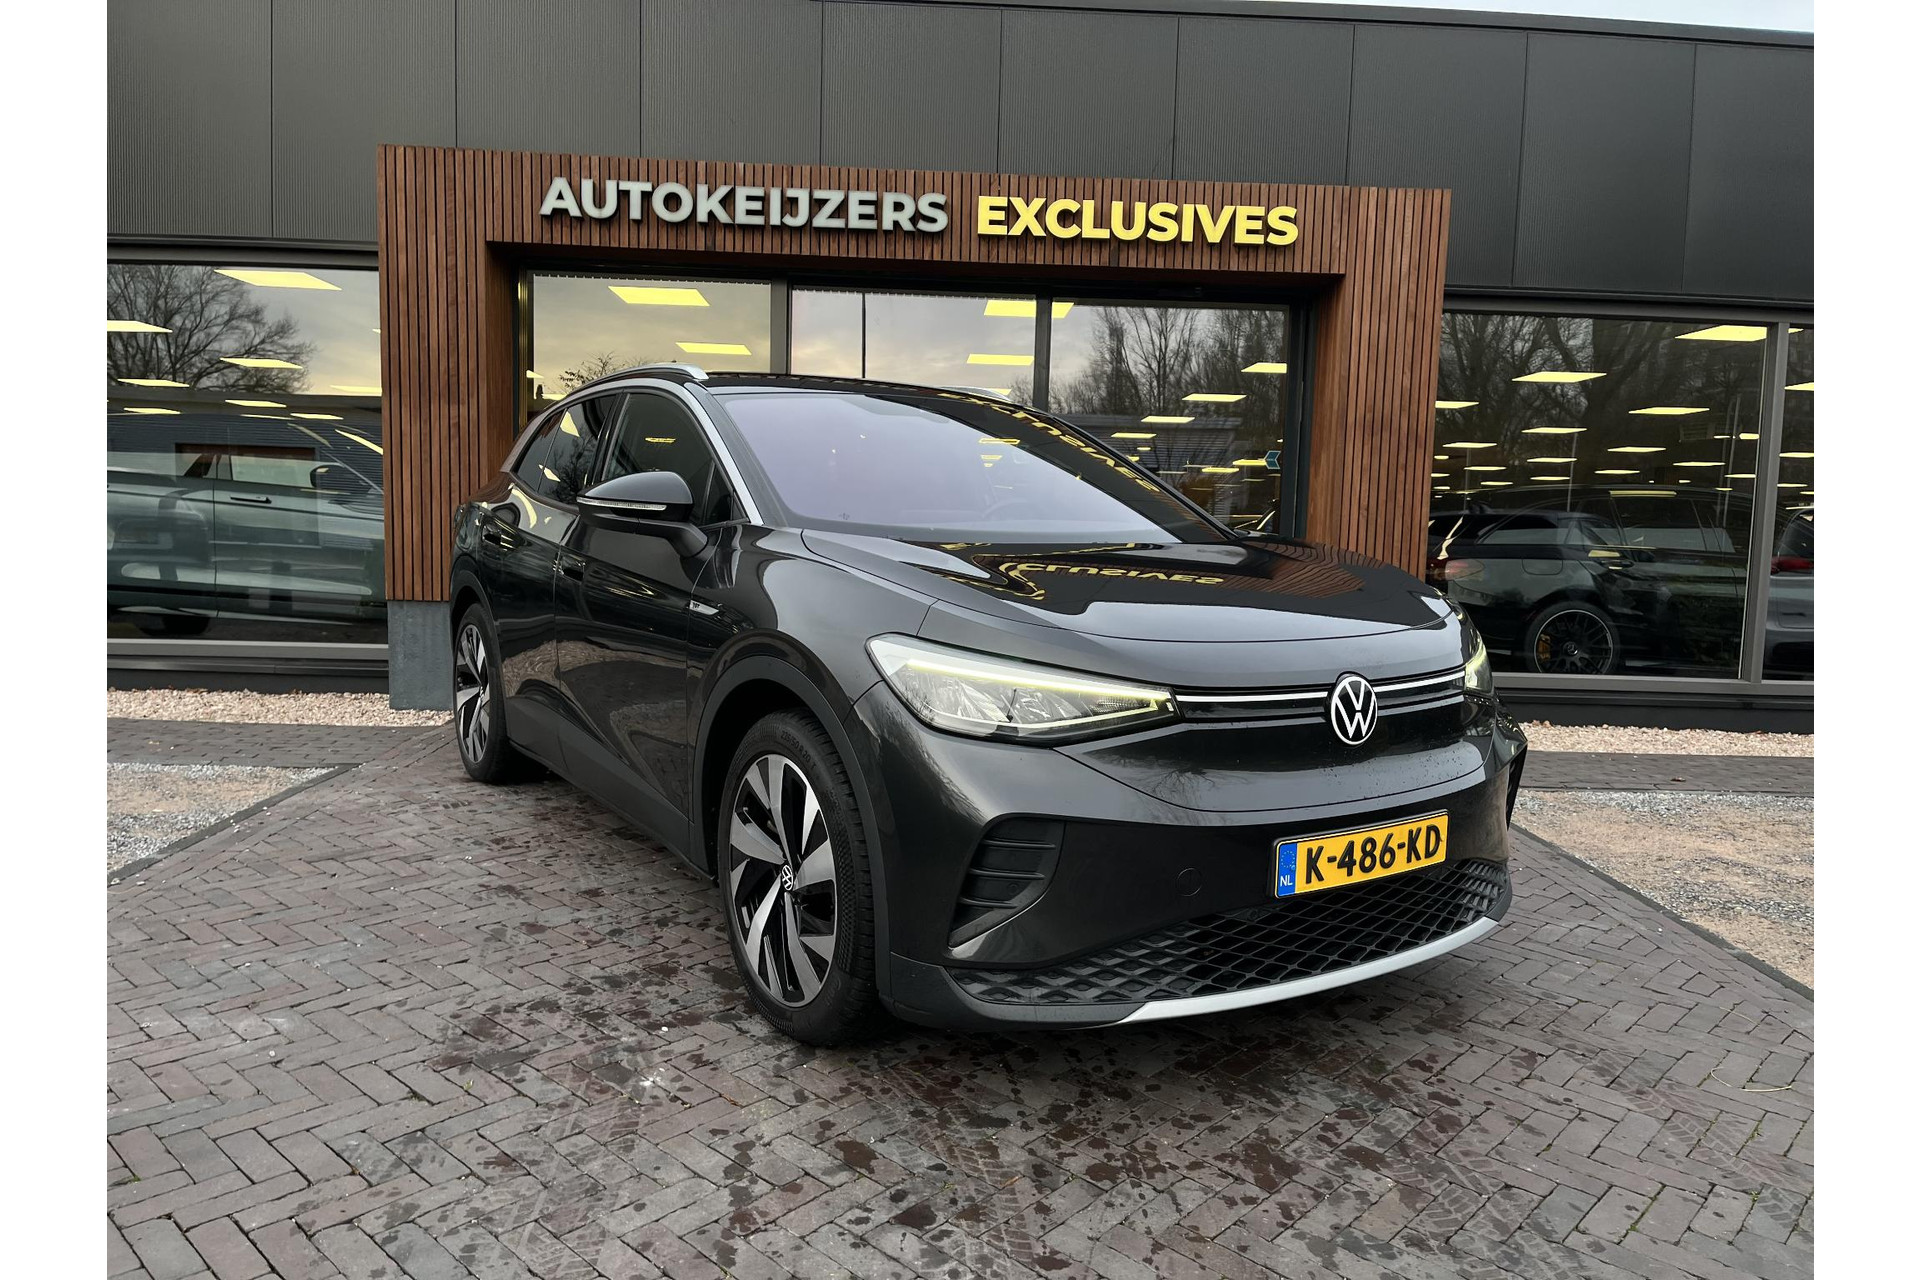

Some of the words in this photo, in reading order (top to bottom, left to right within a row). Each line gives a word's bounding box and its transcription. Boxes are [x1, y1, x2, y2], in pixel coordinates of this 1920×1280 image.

[538, 176, 949, 233] AUTOKEIJZERS
[977, 195, 1300, 247] EXCLUSIVES
[1280, 874, 1293, 887] NL
[1305, 824, 1442, 885] K-486-KD
